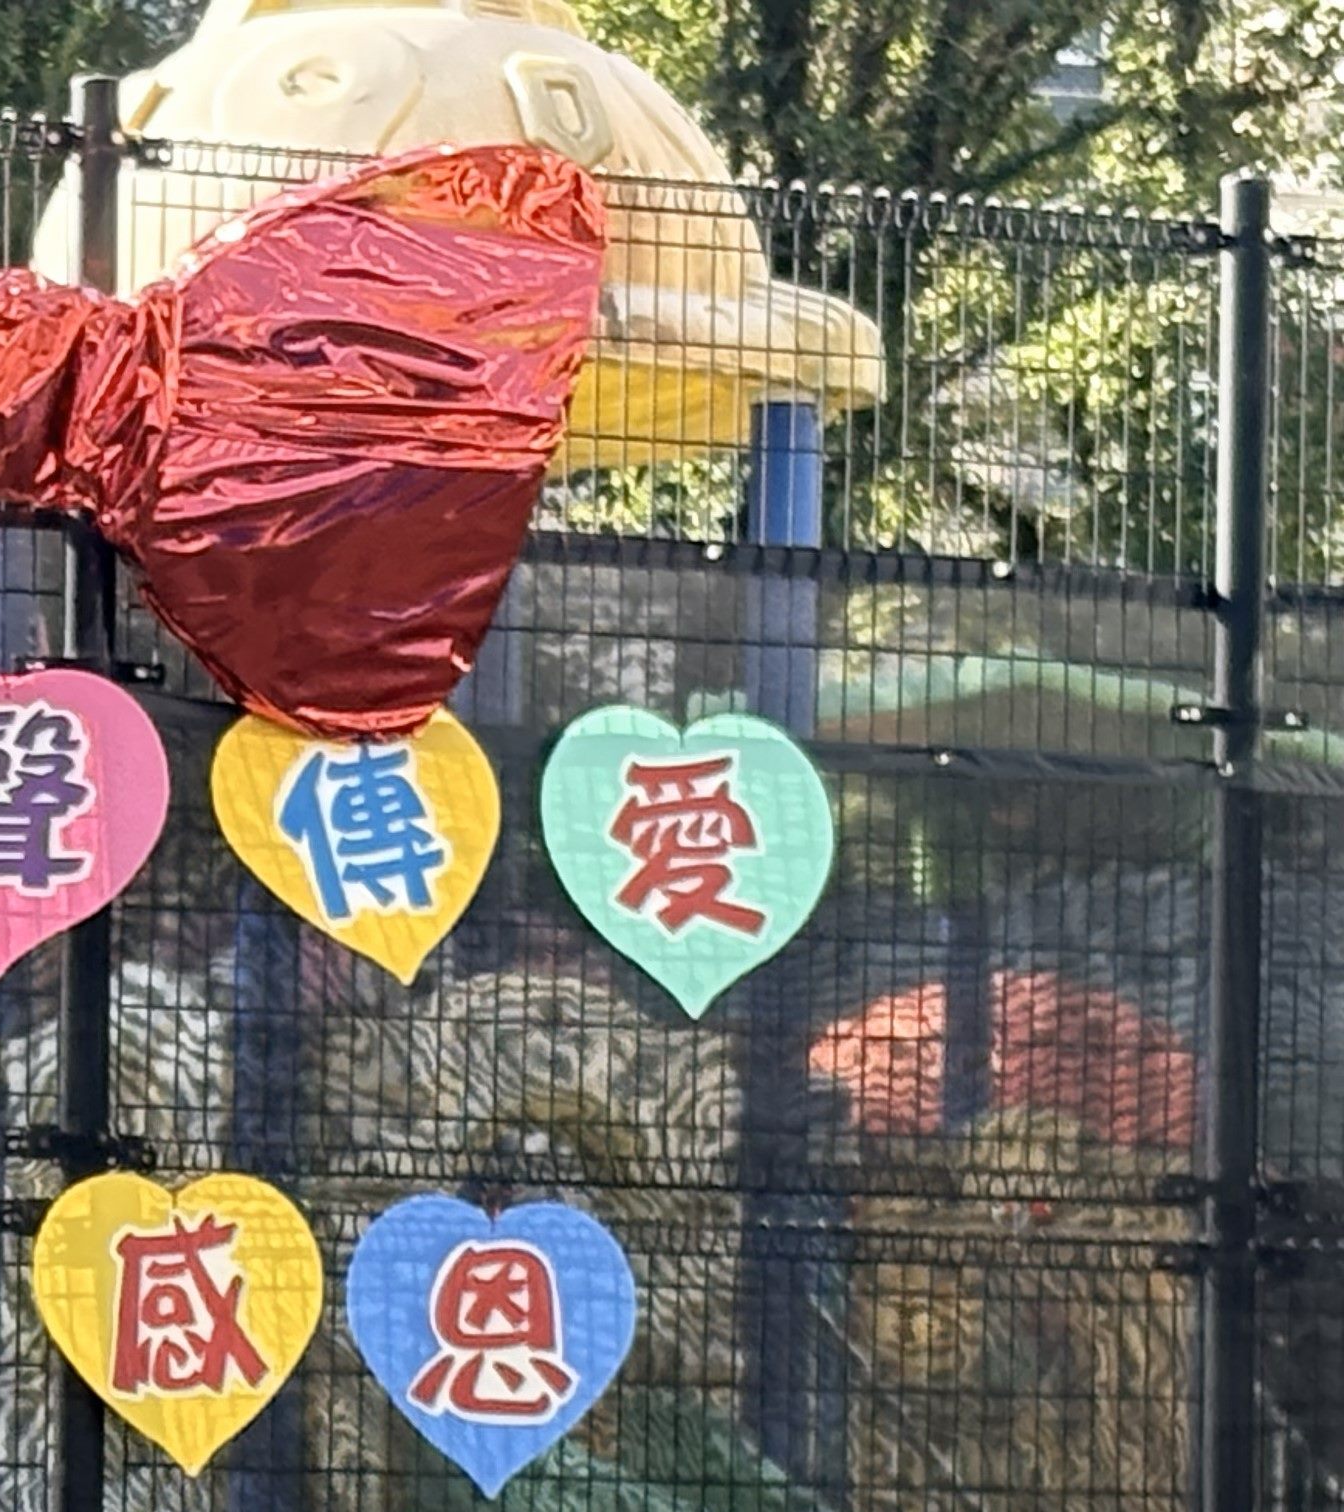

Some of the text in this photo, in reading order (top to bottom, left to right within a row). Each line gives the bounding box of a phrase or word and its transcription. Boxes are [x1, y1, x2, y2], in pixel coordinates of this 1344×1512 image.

[277, 742, 447, 920] 傳
[609, 755, 766, 936] 愛
[113, 1213, 269, 1395] 感
[411, 1245, 578, 1417] 恩
